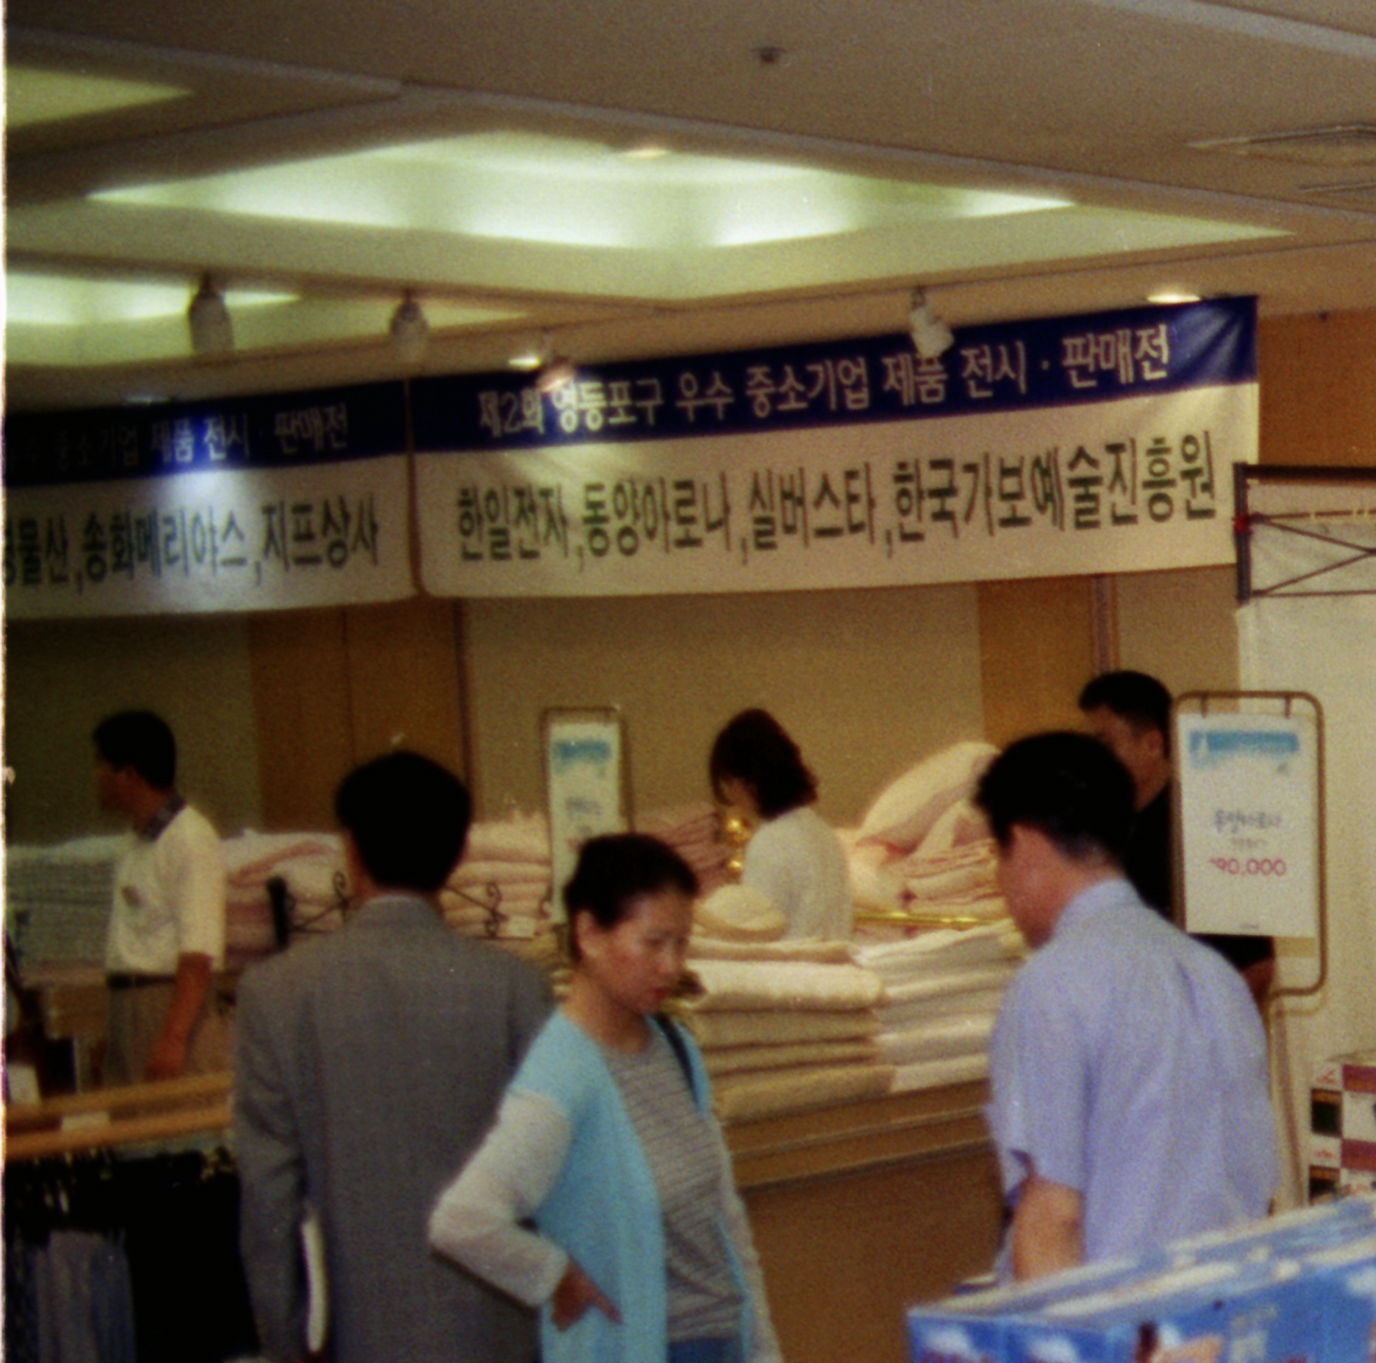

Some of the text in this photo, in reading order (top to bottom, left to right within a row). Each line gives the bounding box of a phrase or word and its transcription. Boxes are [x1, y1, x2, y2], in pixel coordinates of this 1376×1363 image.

[478, 324, 1170, 438] 제2회 영등포구 우수 중소기업 제품 전시 판매전
[202, 412, 253, 462] 전시
[273, 402, 350, 455] 판매전
